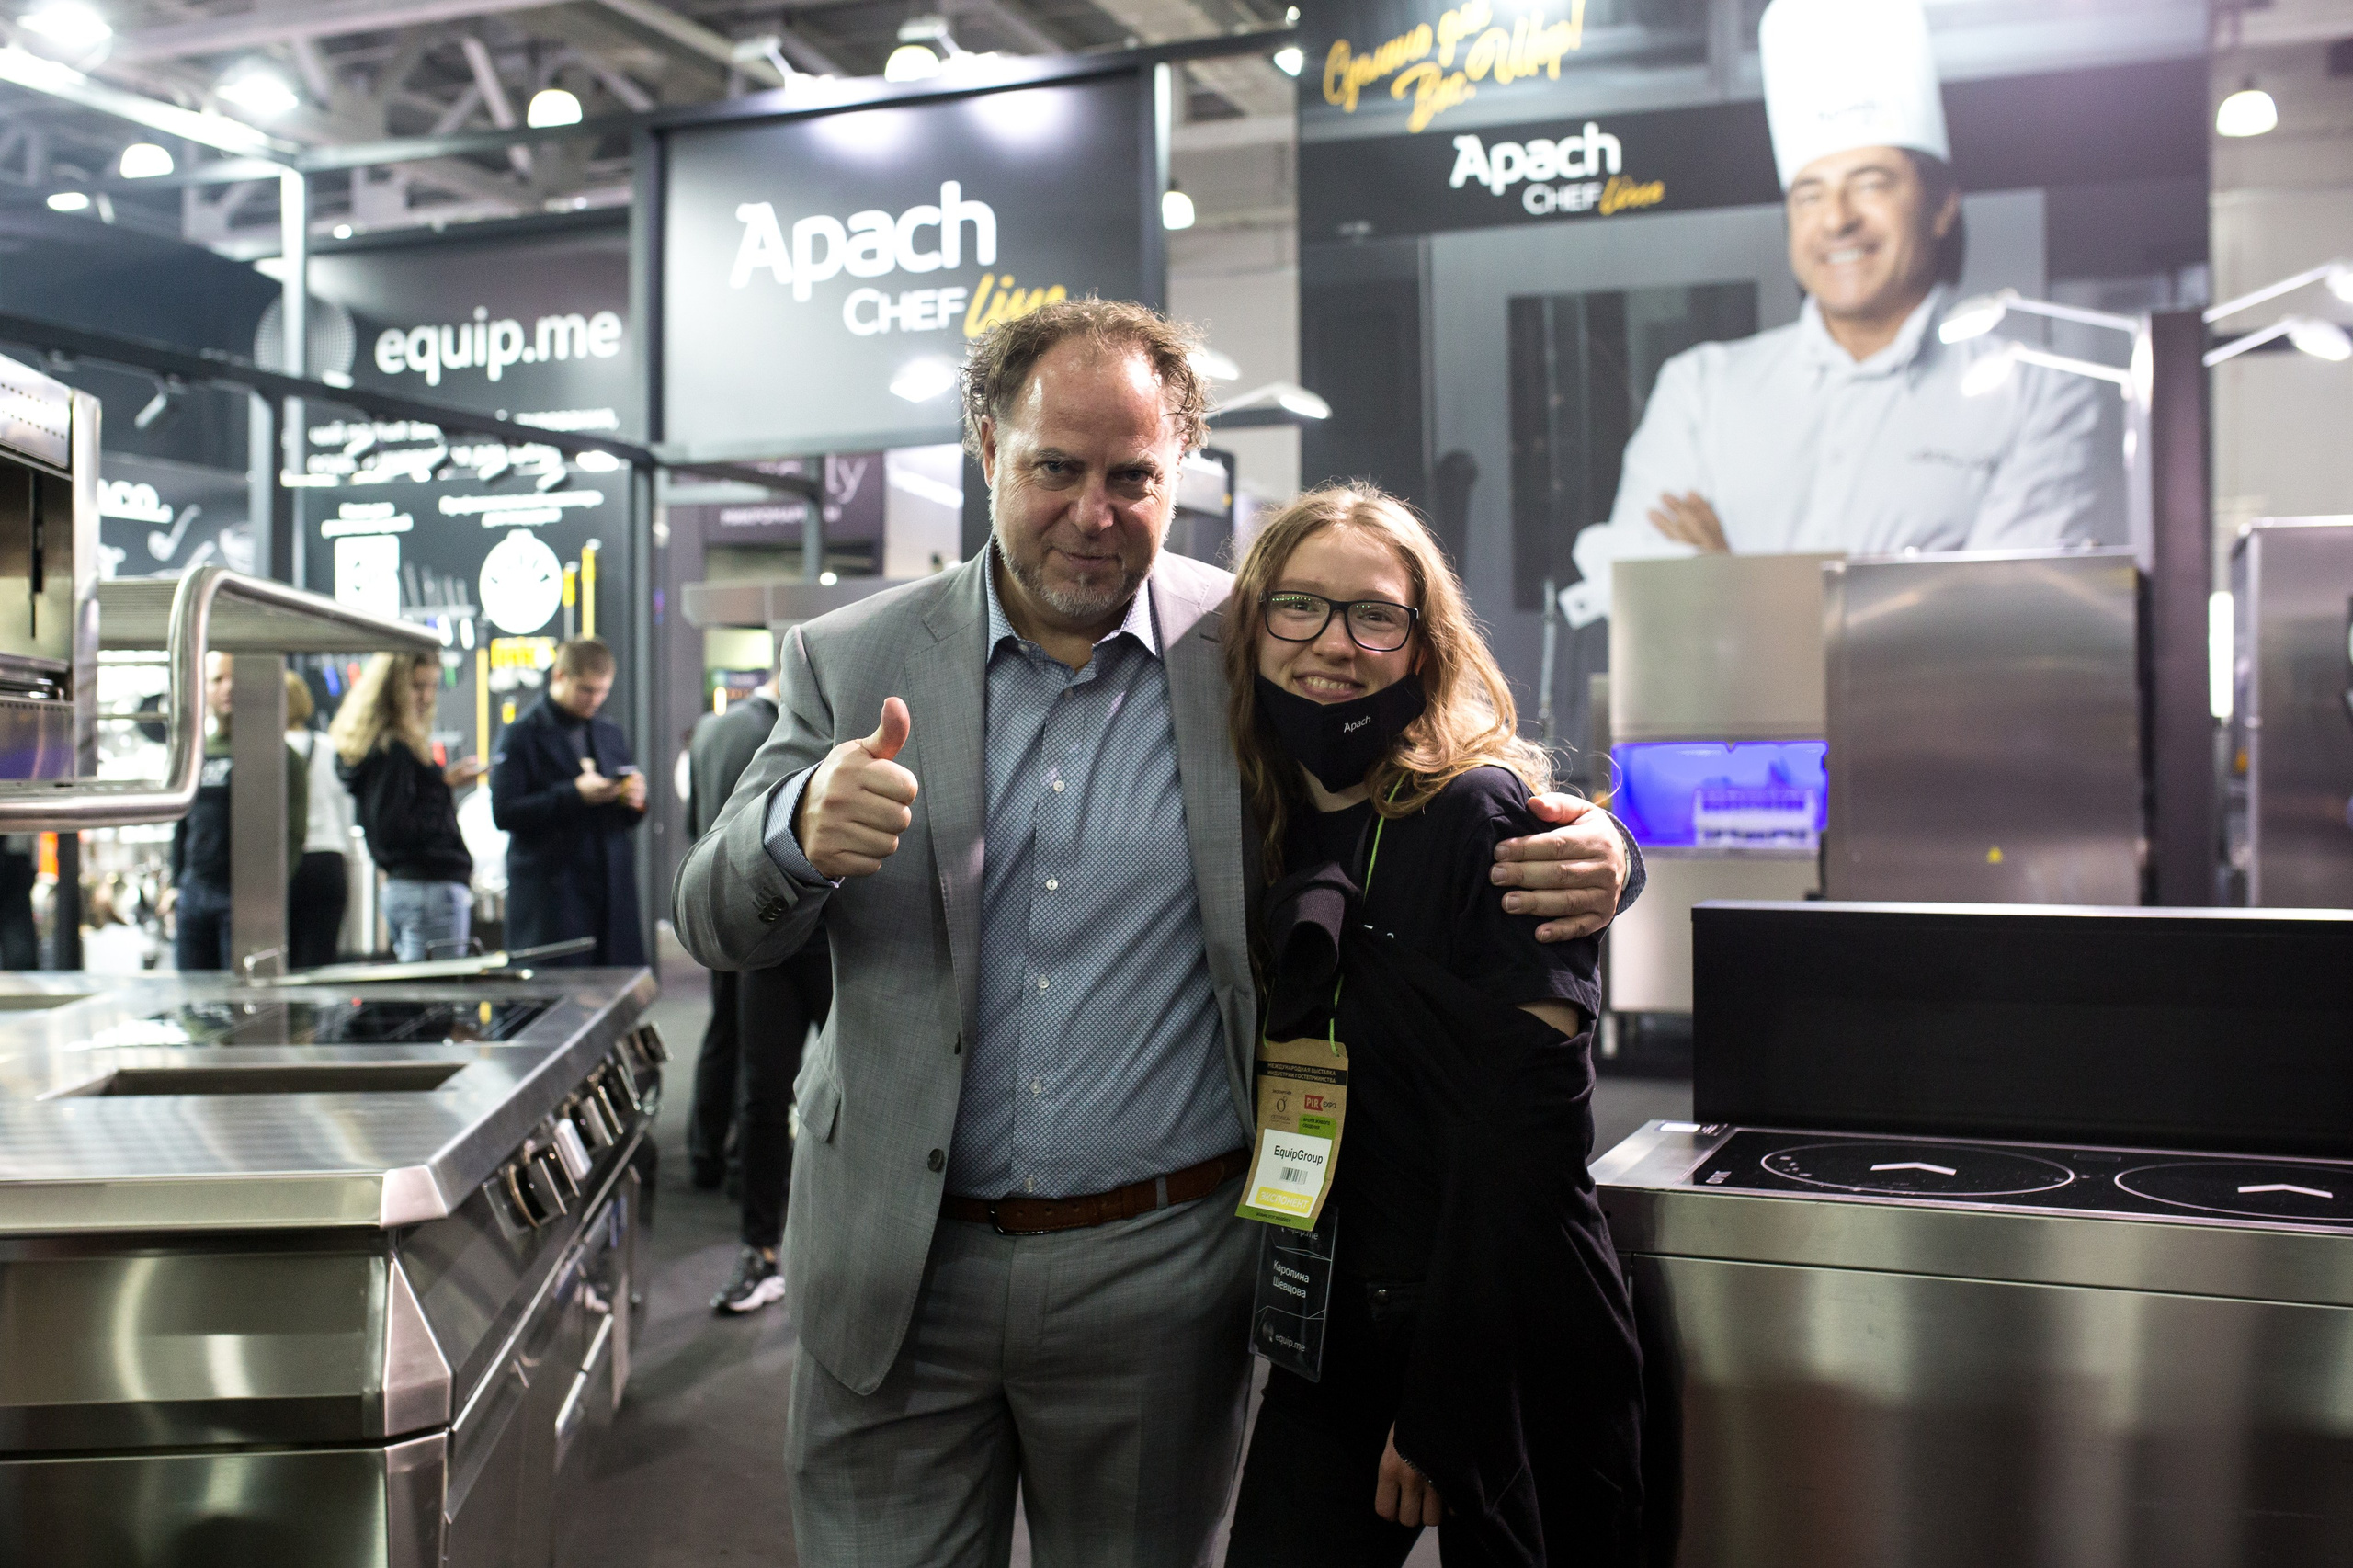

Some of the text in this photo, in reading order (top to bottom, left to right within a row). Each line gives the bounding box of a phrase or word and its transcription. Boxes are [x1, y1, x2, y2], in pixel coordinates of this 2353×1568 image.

[1449, 122, 1621, 196] Apach
[1522, 181, 1603, 215] CHEF
[729, 180, 996, 301] Apach
[843, 286, 967, 336] CHEF
[375, 306, 622, 386] equip.me
[1343, 715, 1371, 733] Apach
[1267, 1062, 1336, 1076] МЕЖДУНАРОДНАЯ ВЫСТАВКА
[1306, 1097, 1319, 1108] PIR
[1274, 1145, 1324, 1165] EquipGroup
[1259, 1191, 1309, 1210] ЭКСПОНЕНТ
[1273, 1259, 1310, 1284] Каролина
[1273, 1276, 1306, 1298] Шевцова
[1275, 1333, 1305, 1352] equip.me
